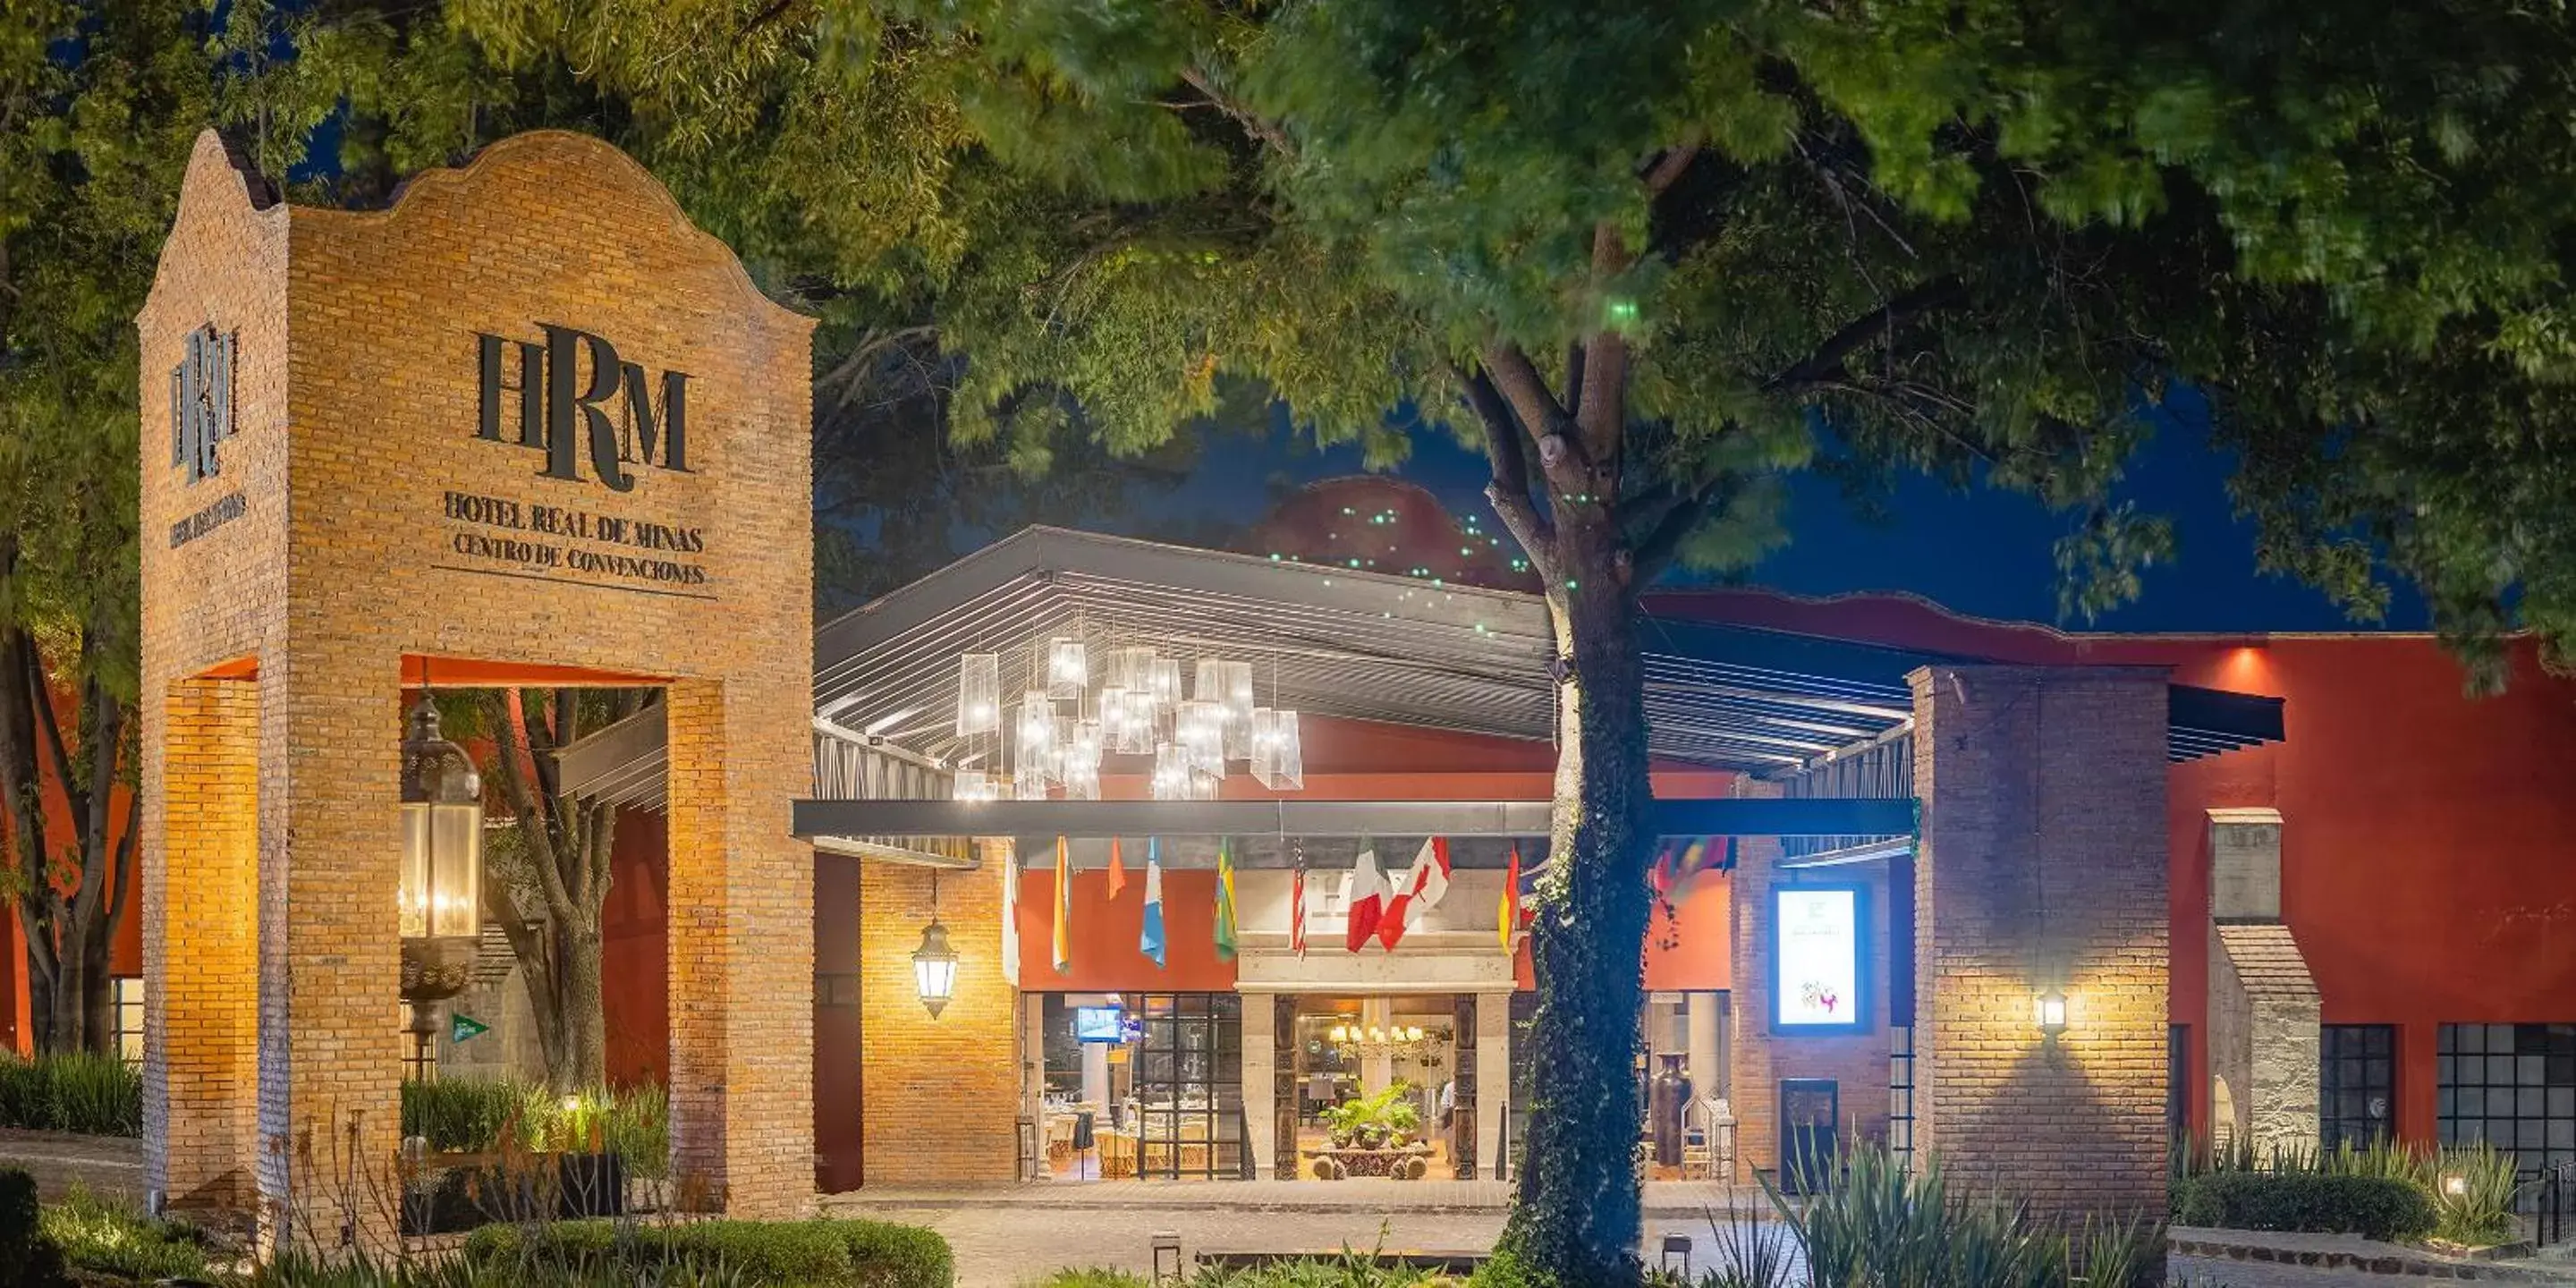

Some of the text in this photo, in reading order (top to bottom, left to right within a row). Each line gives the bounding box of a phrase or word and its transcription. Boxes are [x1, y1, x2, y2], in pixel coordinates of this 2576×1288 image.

[470, 320, 695, 493] HRM
[445, 491, 704, 553] HOTEL REAL DE MINAS
[453, 533, 706, 584] CENTRO DE CONVENCIONES
